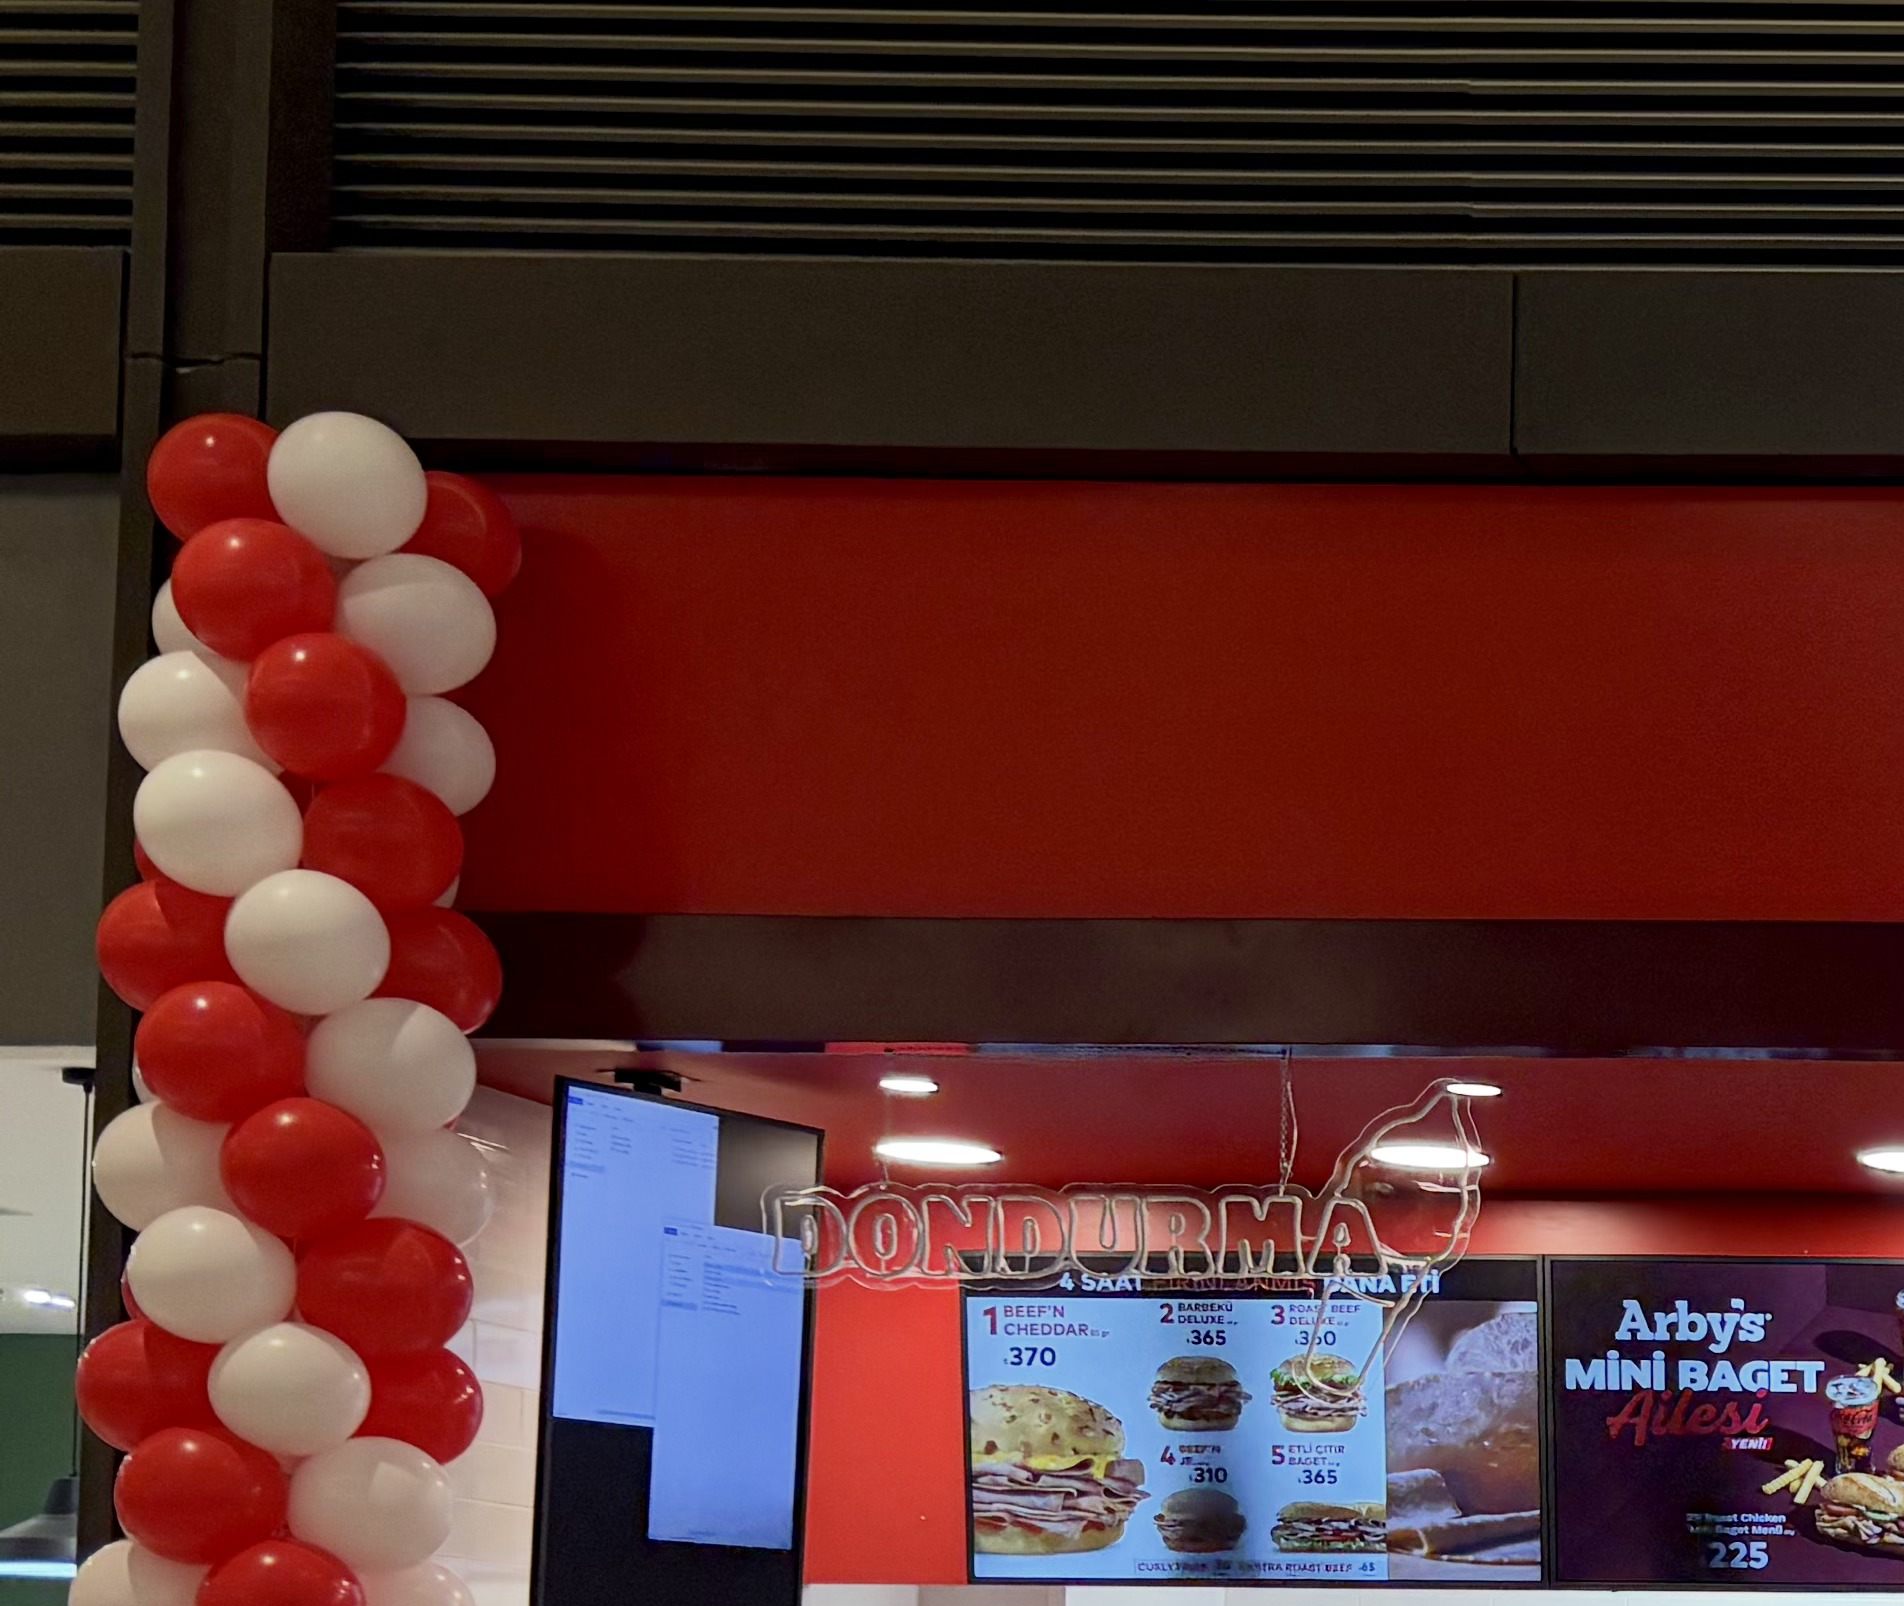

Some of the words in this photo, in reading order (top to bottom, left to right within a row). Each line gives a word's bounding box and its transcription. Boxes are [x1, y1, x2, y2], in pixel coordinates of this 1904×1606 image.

[773, 1193, 1386, 1278] DONDURMA
[1082, 1272, 1143, 1291] SAAT
[1323, 1275, 1396, 1294] DANA
[1004, 1305, 1065, 1319] BEEF'N
[1178, 1301, 1233, 1313] BARBEKÜ
[1330, 1304, 1361, 1314] BEEF
[1178, 1315, 1225, 1325] DELUXE
[1615, 1298, 1766, 1354] Arby's
[1004, 1322, 1089, 1336] CHEDDAR
[1565, 1350, 1665, 1390] MİNİ
[1678, 1360, 1825, 1392] BAGET
[1606, 1389, 1770, 1446] Ailesi
[1289, 1457, 1326, 1466] BAGET
[1741, 1513, 1786, 1522] Chicken
[1709, 1542, 1768, 1569] 225
